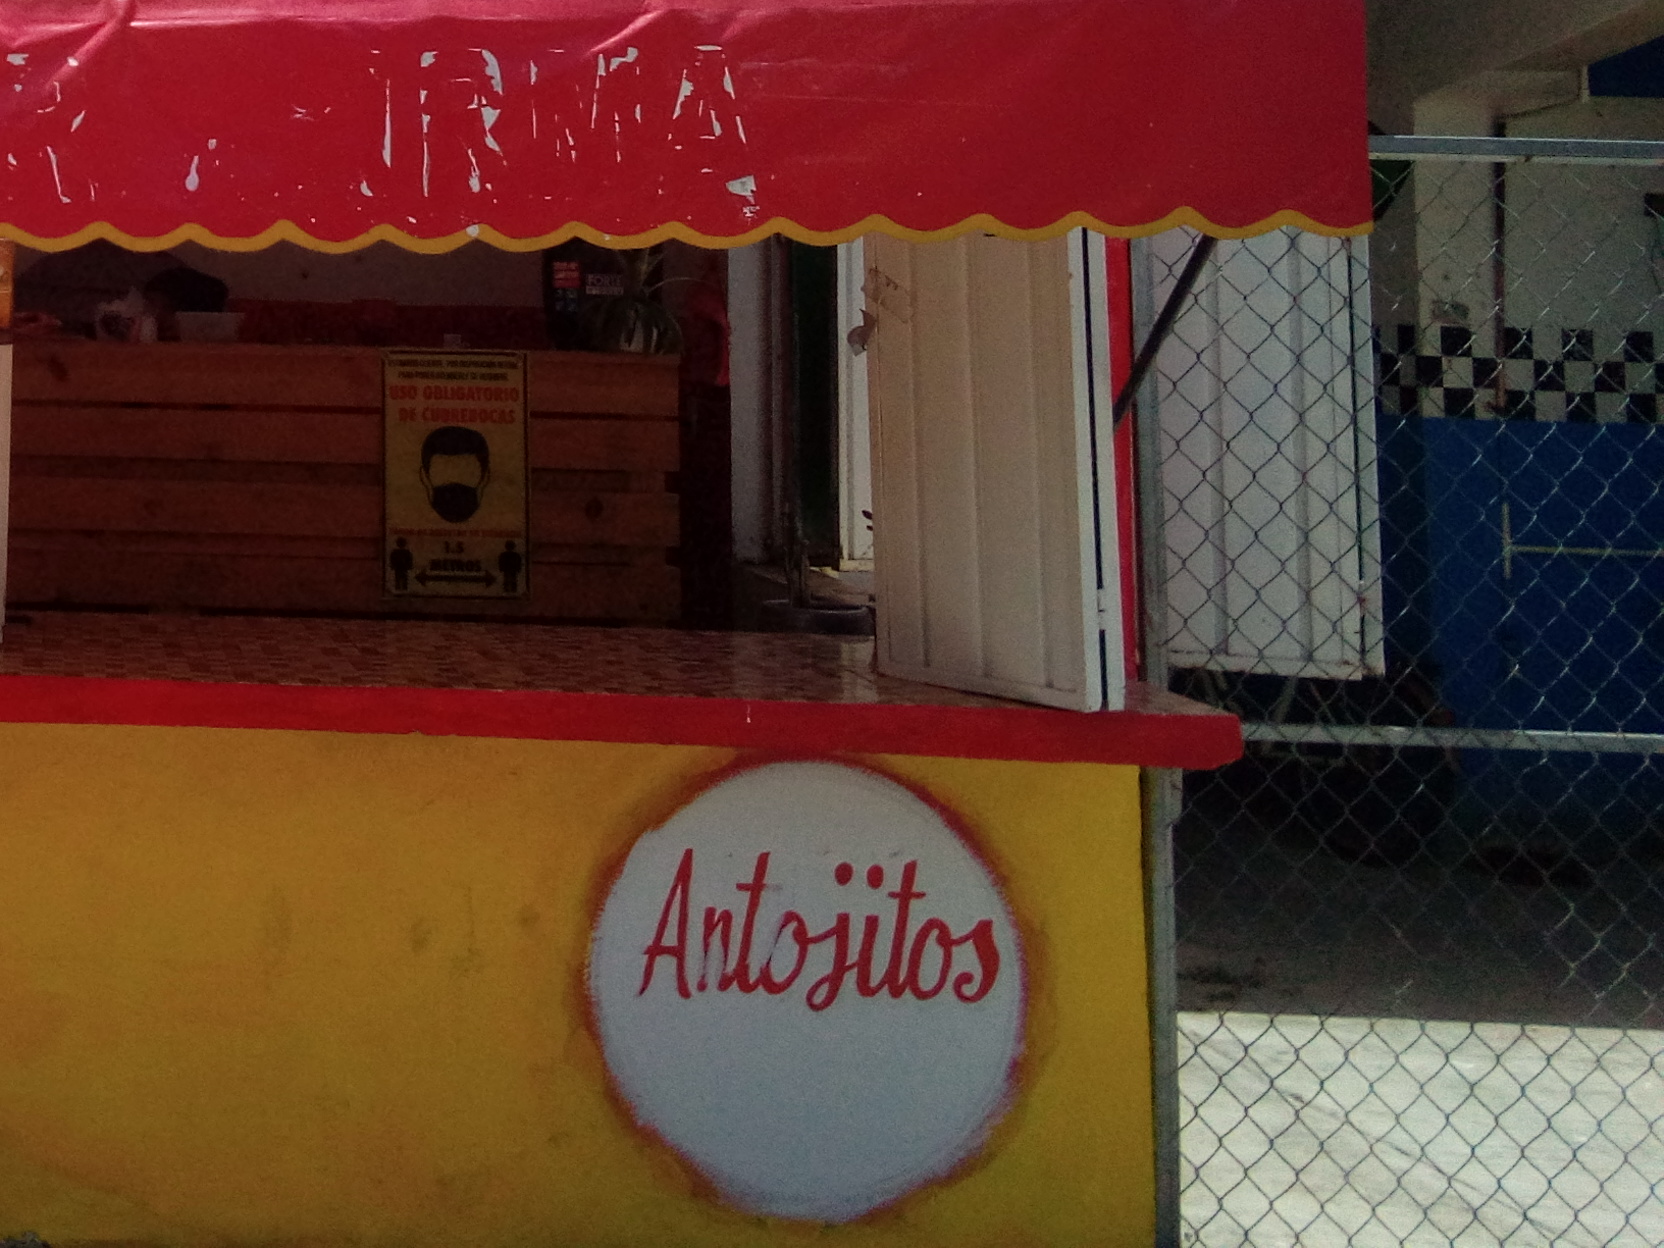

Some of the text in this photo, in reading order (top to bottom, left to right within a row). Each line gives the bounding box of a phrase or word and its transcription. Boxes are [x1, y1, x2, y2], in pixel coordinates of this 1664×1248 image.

[389, 385, 519, 402] USO OBLIGATORIO
[398, 407, 515, 424] DE CUBREBOCAS
[443, 540, 465, 554] 1.5
[637, 847, 1002, 1012] Antojitos
